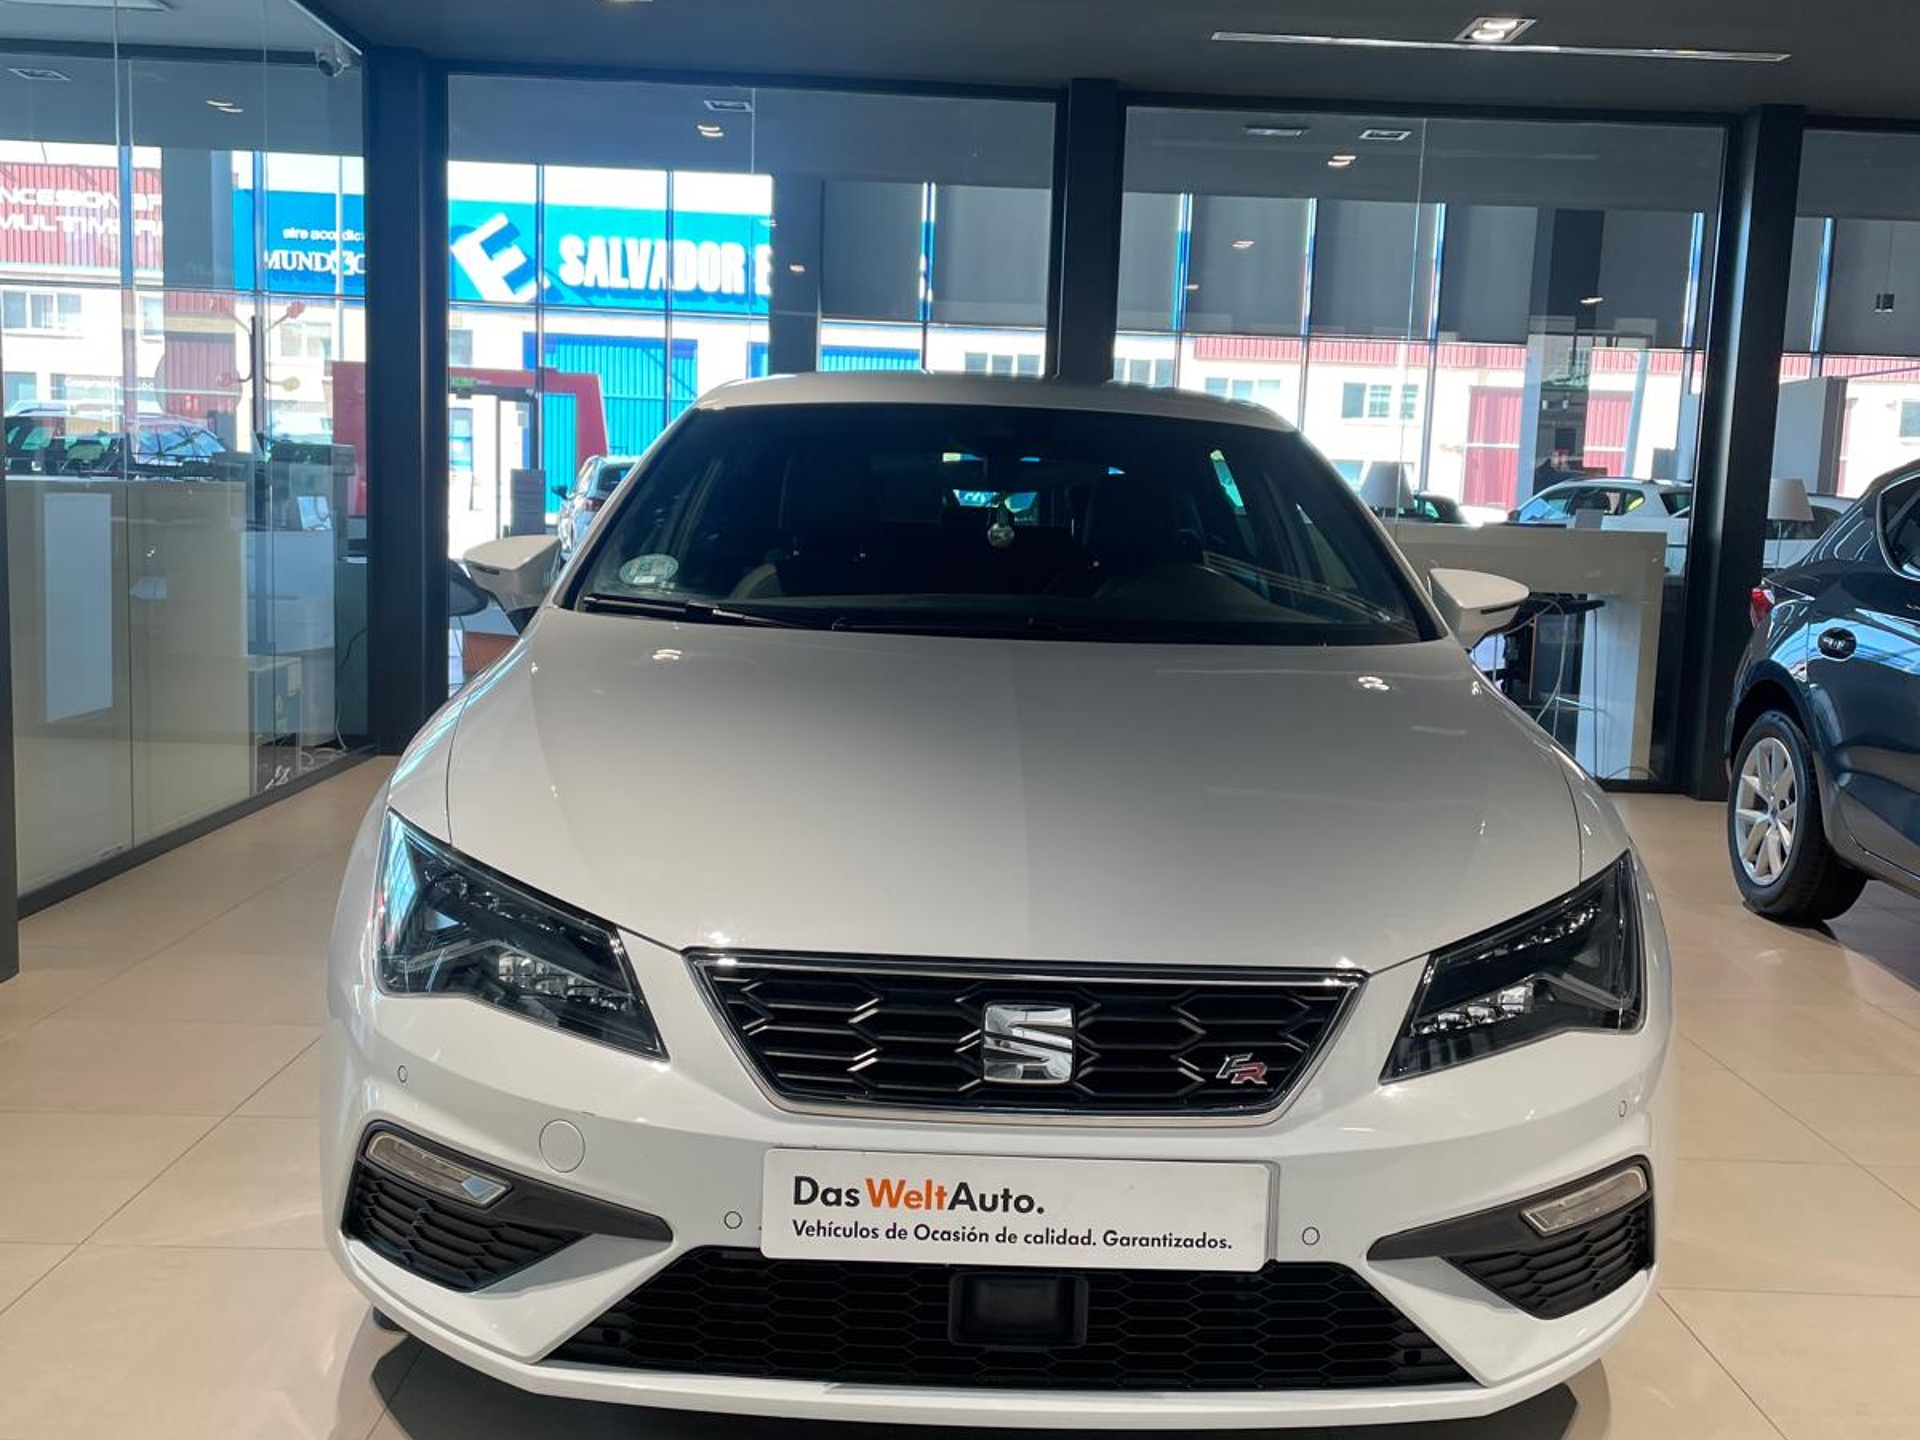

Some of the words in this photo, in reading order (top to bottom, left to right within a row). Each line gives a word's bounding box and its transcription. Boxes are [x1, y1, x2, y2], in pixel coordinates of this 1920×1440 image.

[559, 233, 745, 294] SALVADOR
[1215, 1052, 1268, 1085] FR
[793, 1176, 860, 1208] Das
[792, 1219, 879, 1240] Vehículos
[885, 1222, 908, 1240] de
[913, 1223, 989, 1244] Ocasión
[995, 1227, 1018, 1245] de
[1023, 1227, 1097, 1247] calidad.
[1102, 1230, 1232, 1250] Garantizados.
